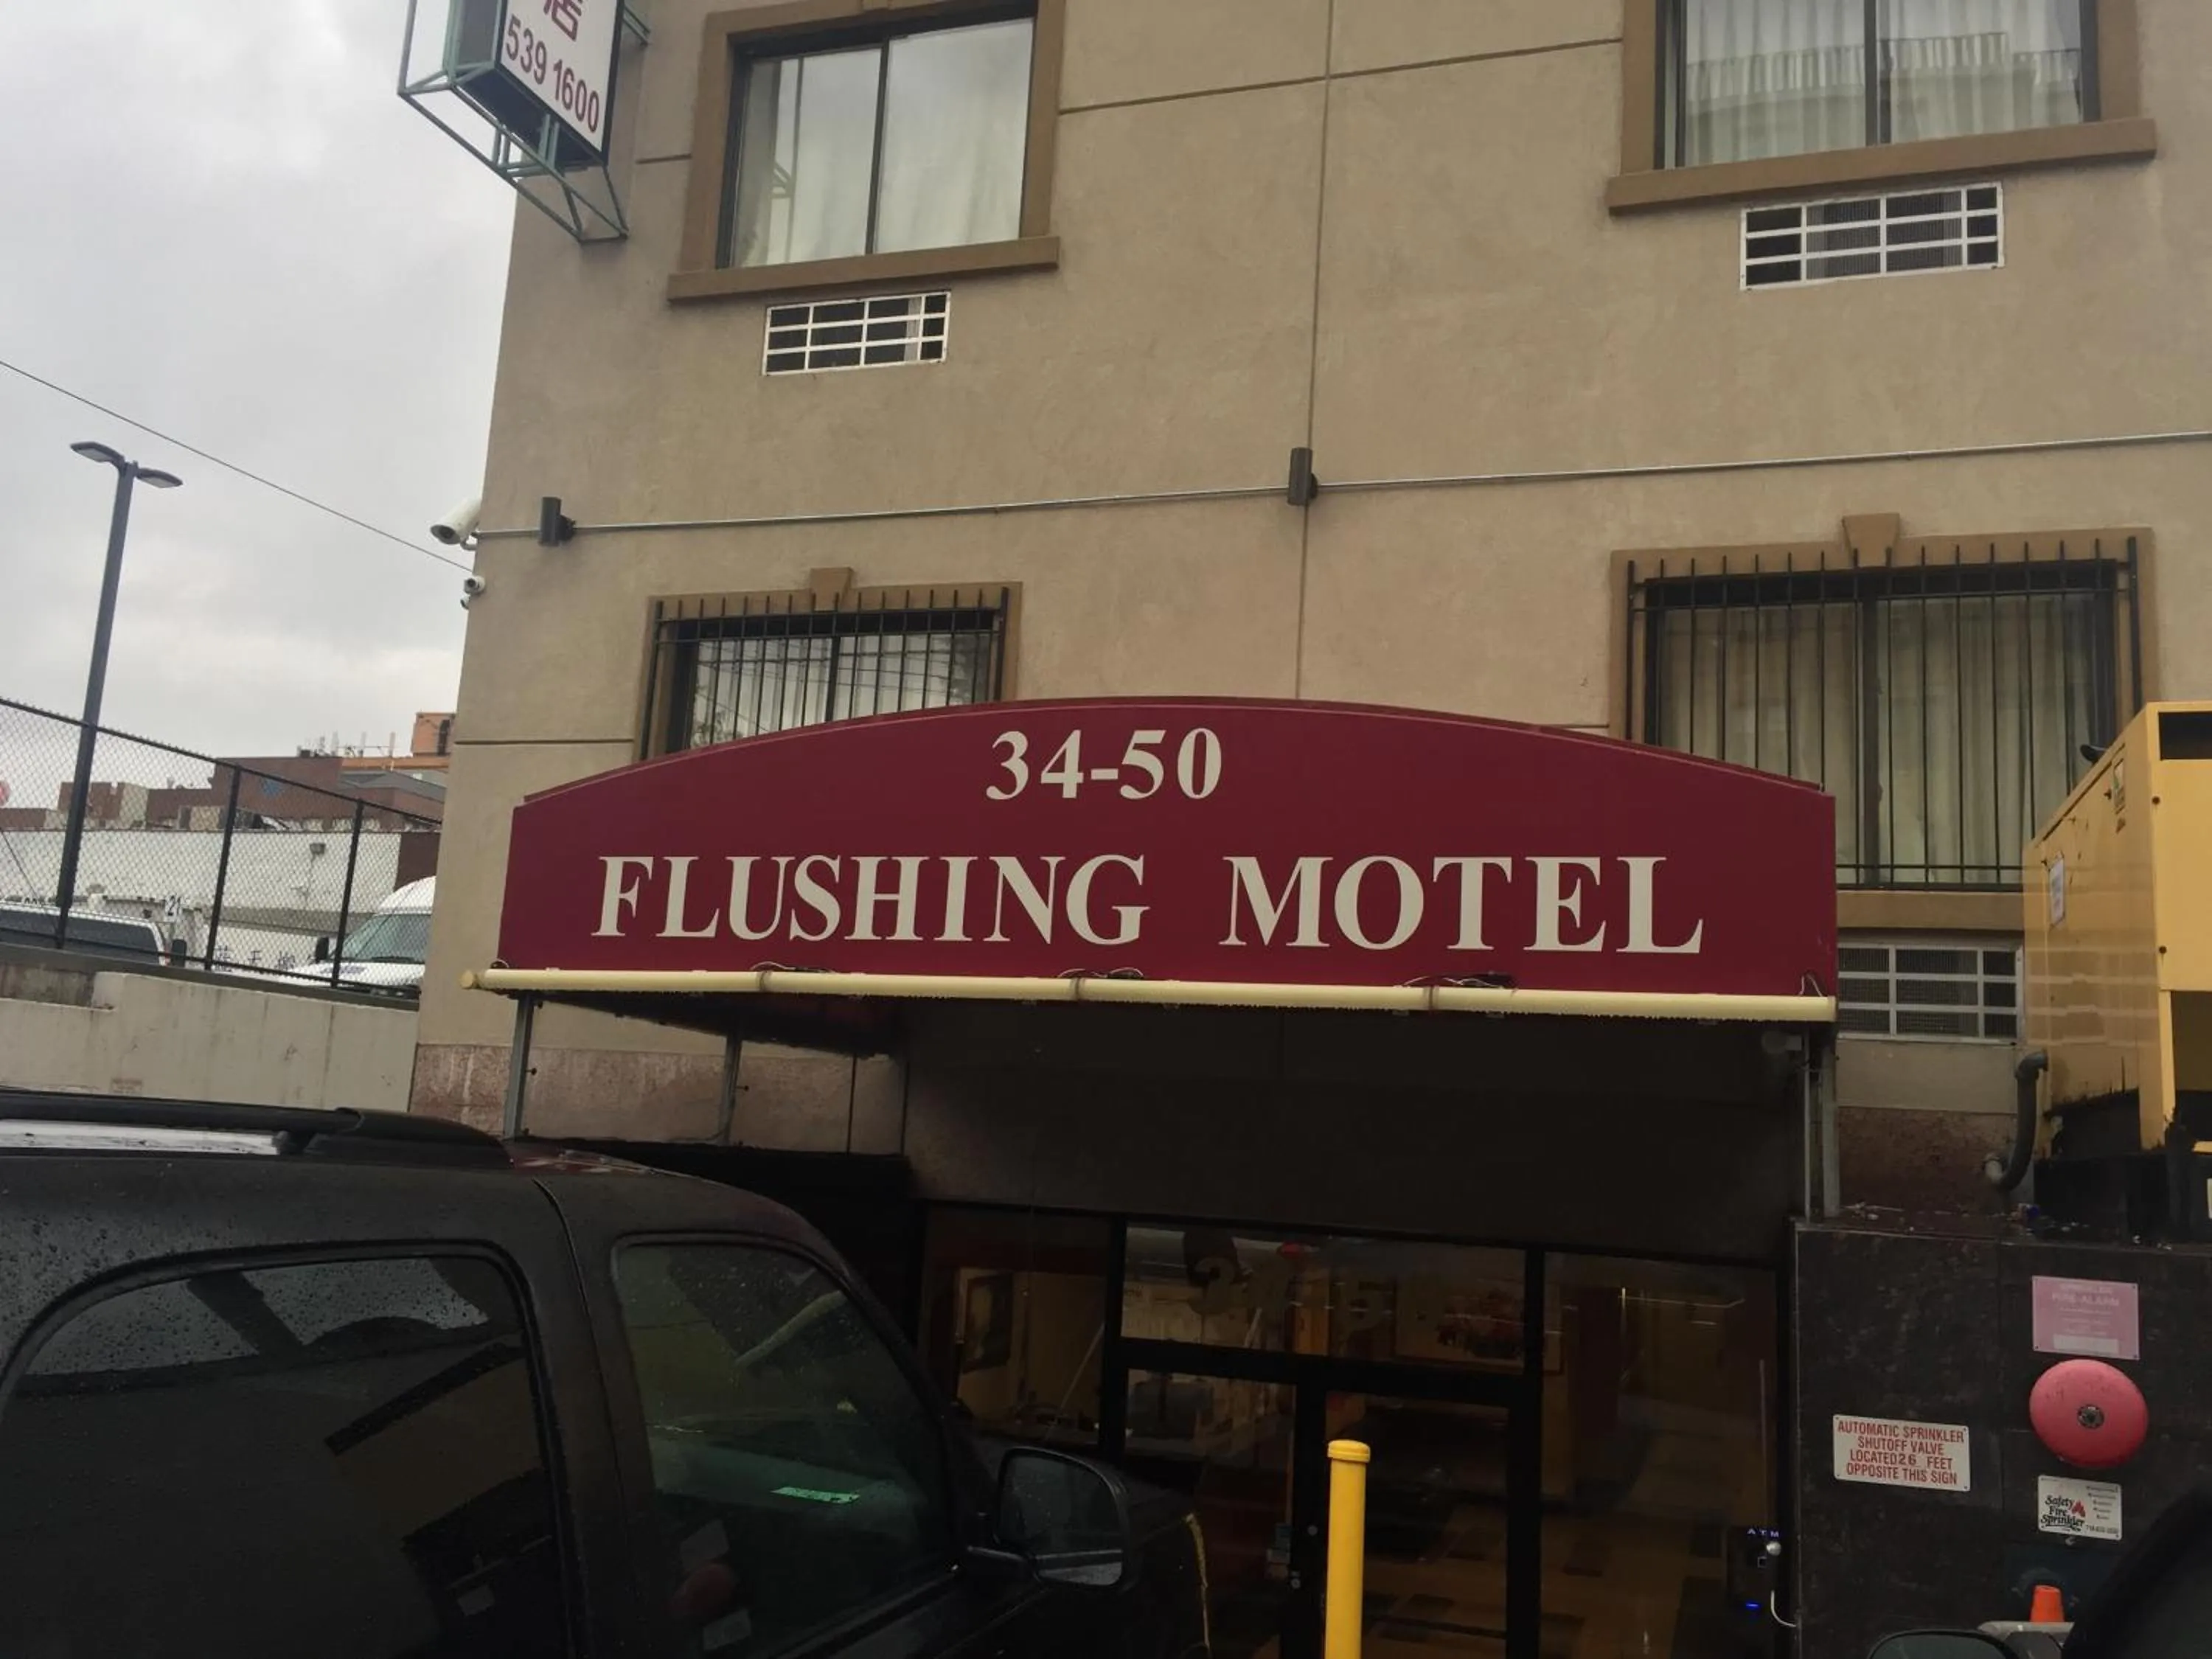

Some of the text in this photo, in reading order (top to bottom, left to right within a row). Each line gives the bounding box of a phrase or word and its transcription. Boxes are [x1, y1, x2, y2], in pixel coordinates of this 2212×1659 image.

[506, 13, 600, 133] 539 1600
[986, 727, 1222, 800] 34-50
[591, 853, 1705, 954] FLUSHING MOTEL
[1838, 1420, 1965, 1443] AUTOMATIC SPRINKLER
[1857, 1436, 1944, 1455] SHUTOFF VALVE
[1850, 1449, 1897, 1465] LOCATED
[1927, 1456, 1953, 1470] FEET
[1846, 1462, 1958, 1485] OPPOSITE THIS SIGN
[2045, 1495, 2073, 1510] Safety
[2049, 1506, 2067, 1517] Fire
[2040, 1514, 2085, 1527] Sprinkler
[1747, 1528, 1779, 1537] ATM
